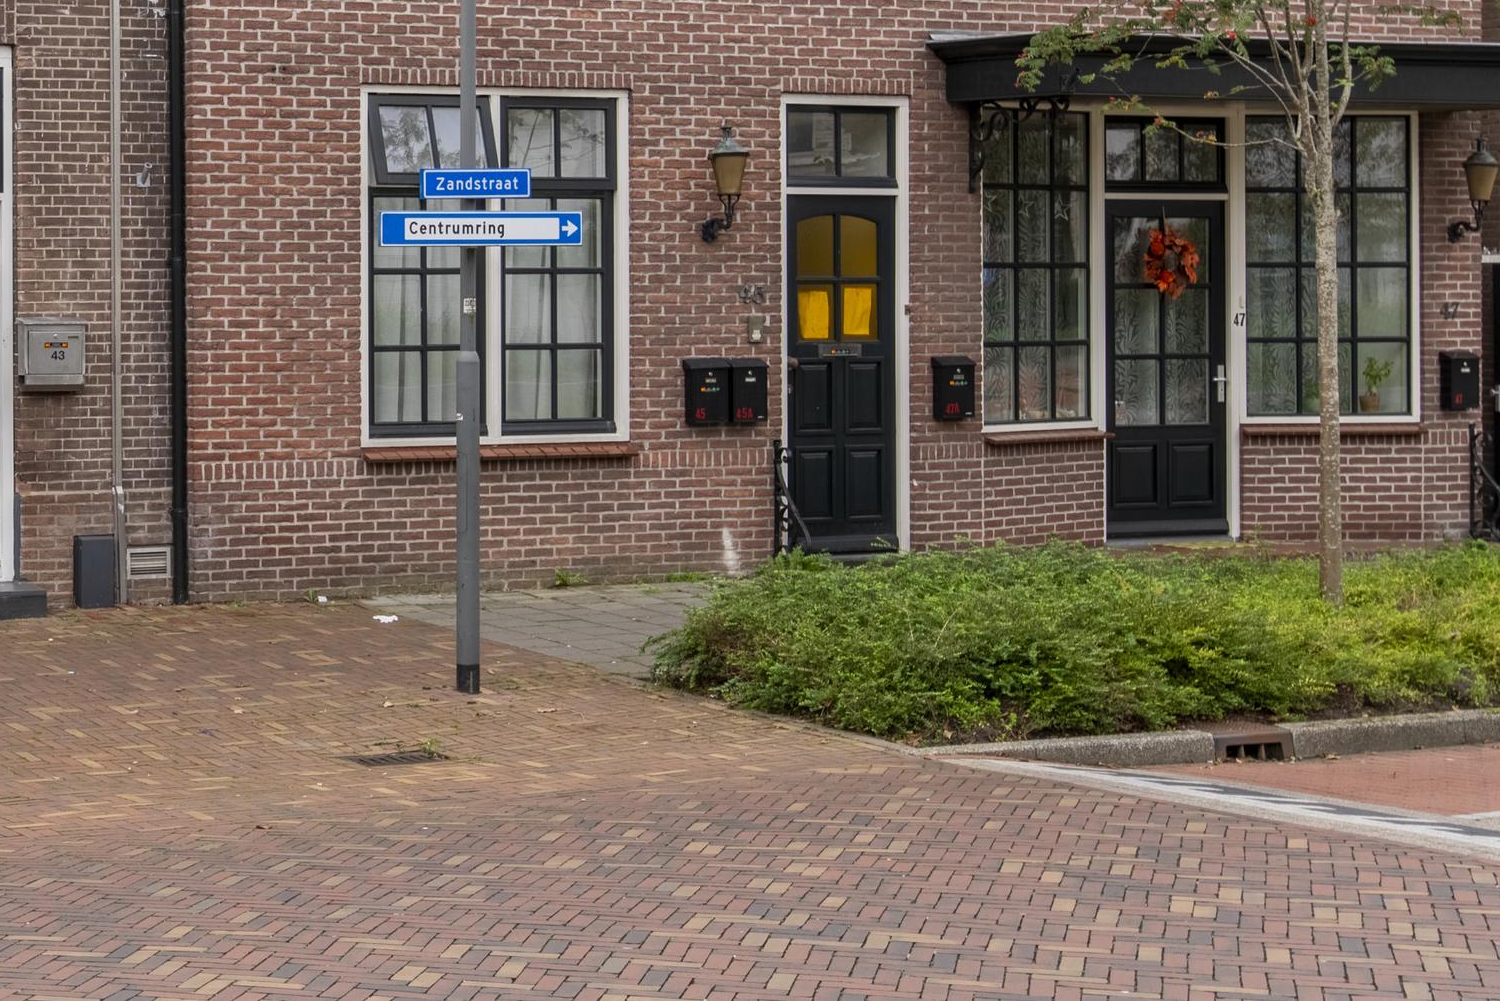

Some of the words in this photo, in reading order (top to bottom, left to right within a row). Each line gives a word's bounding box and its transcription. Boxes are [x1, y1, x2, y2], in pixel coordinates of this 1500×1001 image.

[436, 177, 519, 191] Zandstraat
[409, 221, 505, 238] Centrumring
[1440, 302, 1460, 320] 47
[1233, 312, 1245, 327] 47
[51, 350, 65, 360] 43
[695, 407, 706, 419] 45
